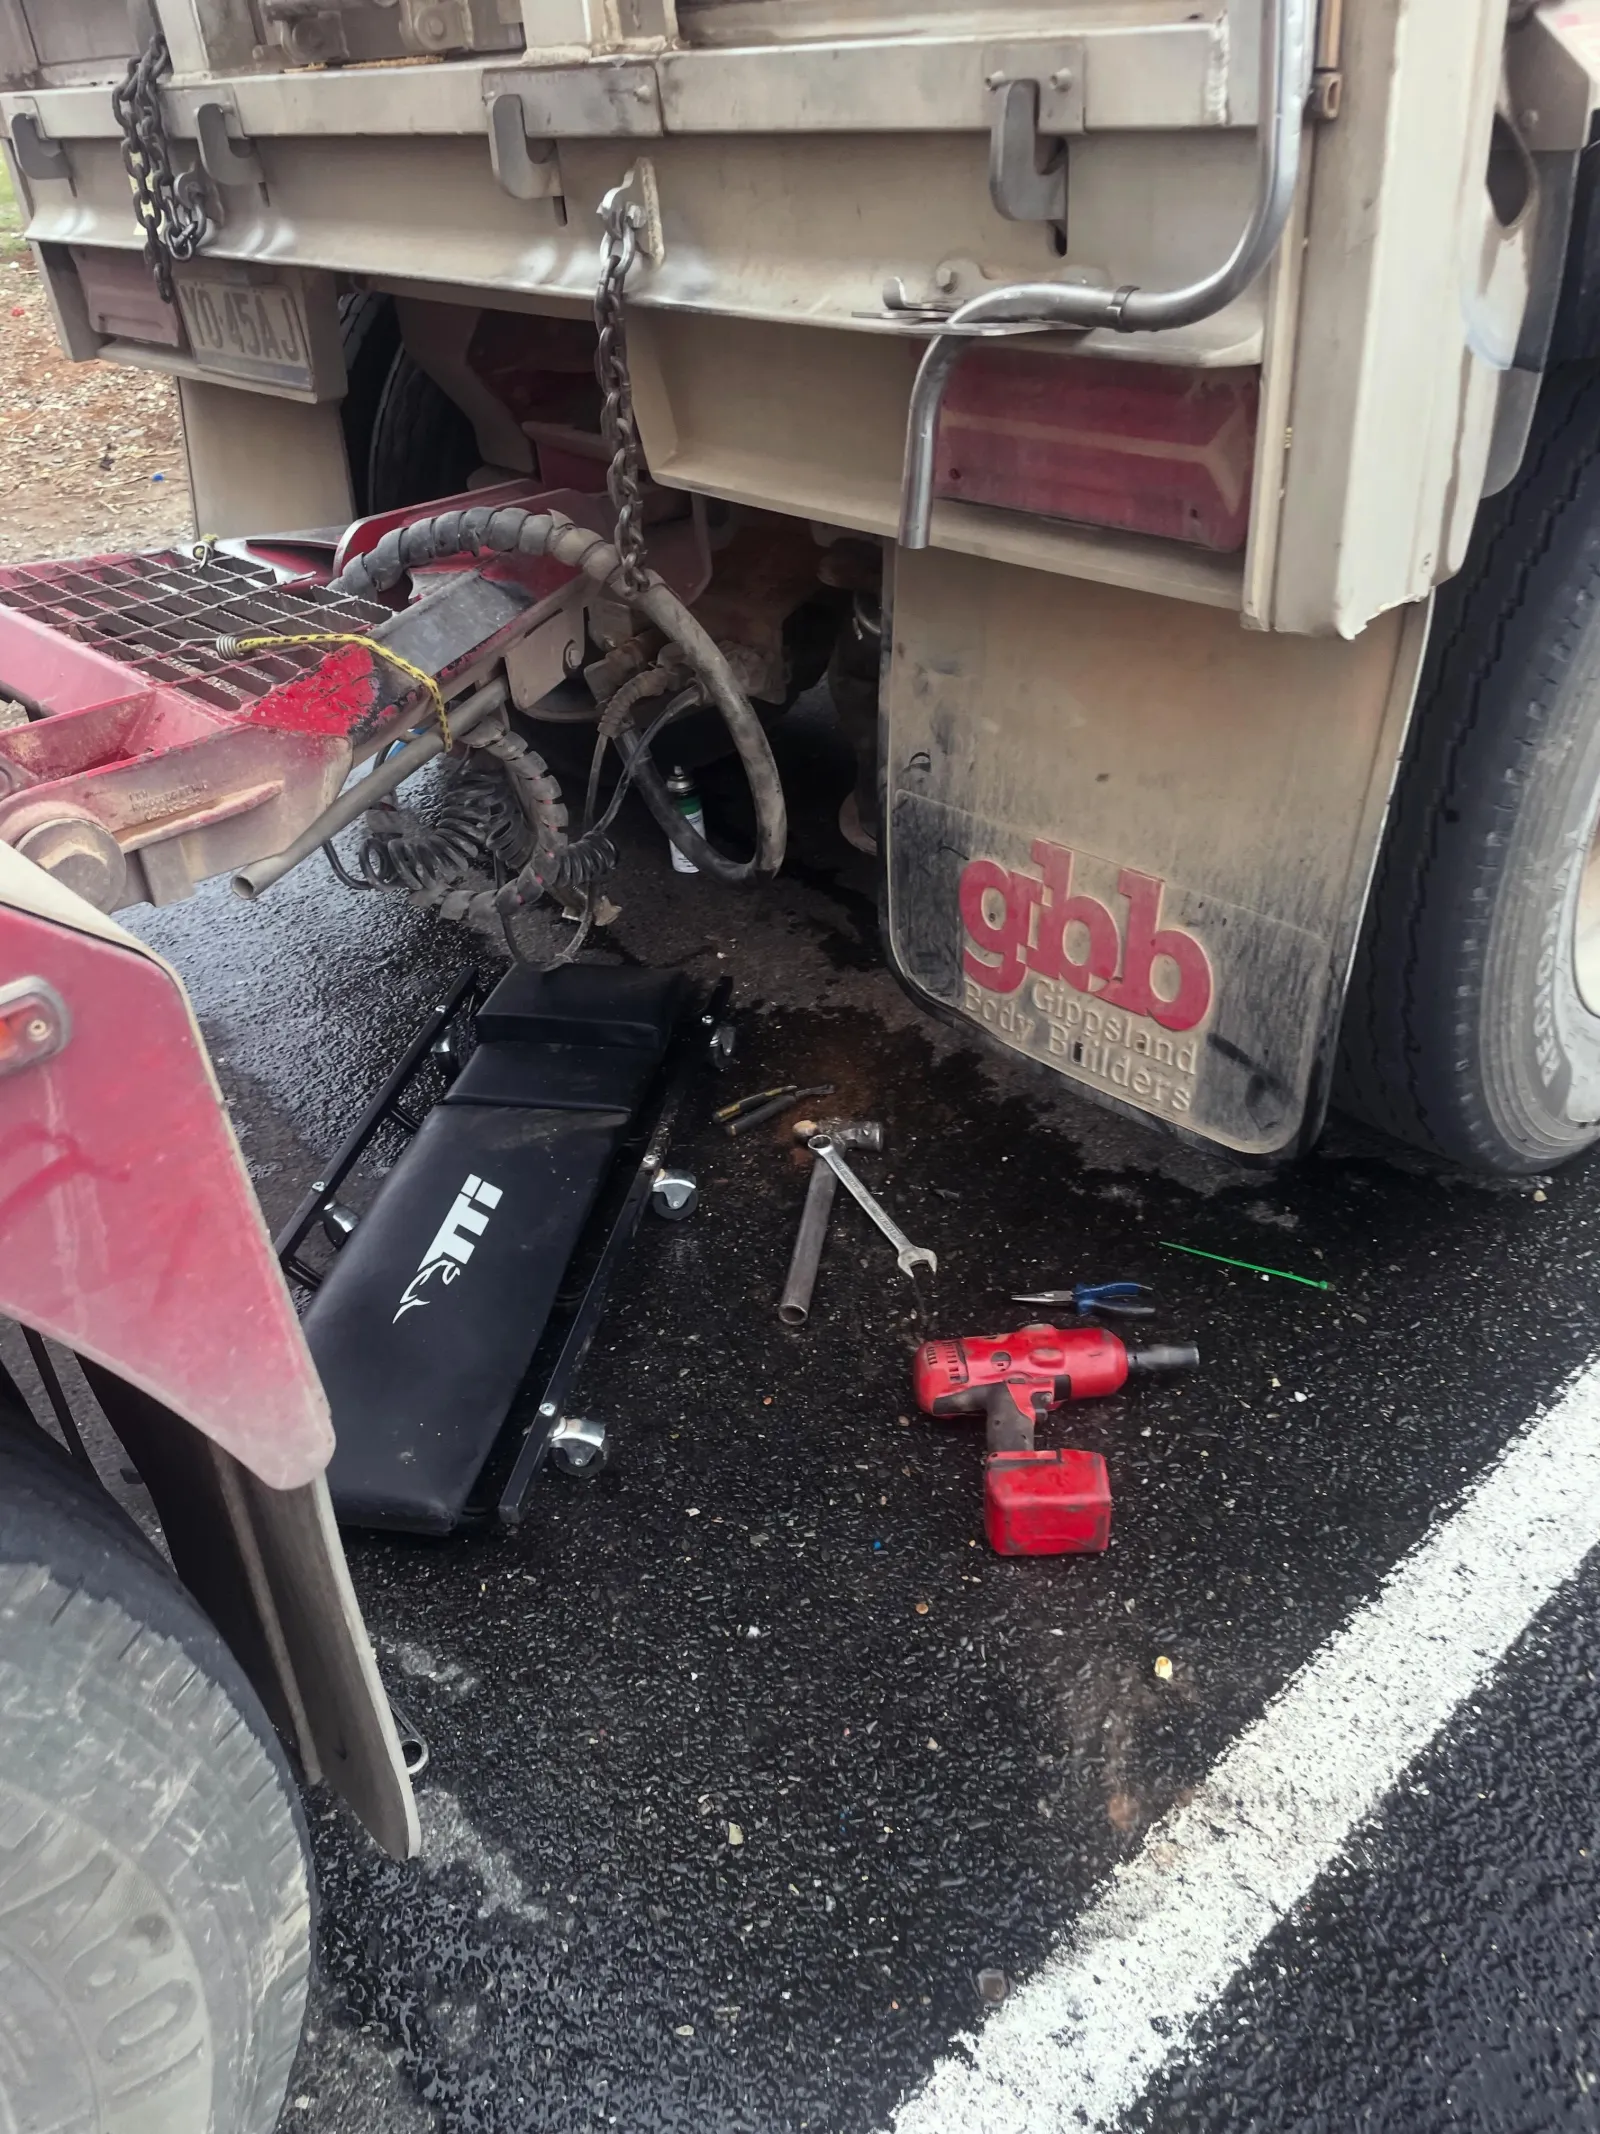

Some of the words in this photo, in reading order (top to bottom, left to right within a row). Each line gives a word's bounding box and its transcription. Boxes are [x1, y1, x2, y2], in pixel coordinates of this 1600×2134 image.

[959, 838, 1214, 1032] gbb
[963, 976, 1035, 1043] Body
[1048, 1019, 1191, 1111] Builders
[1032, 978, 1197, 1075] Gippsland
